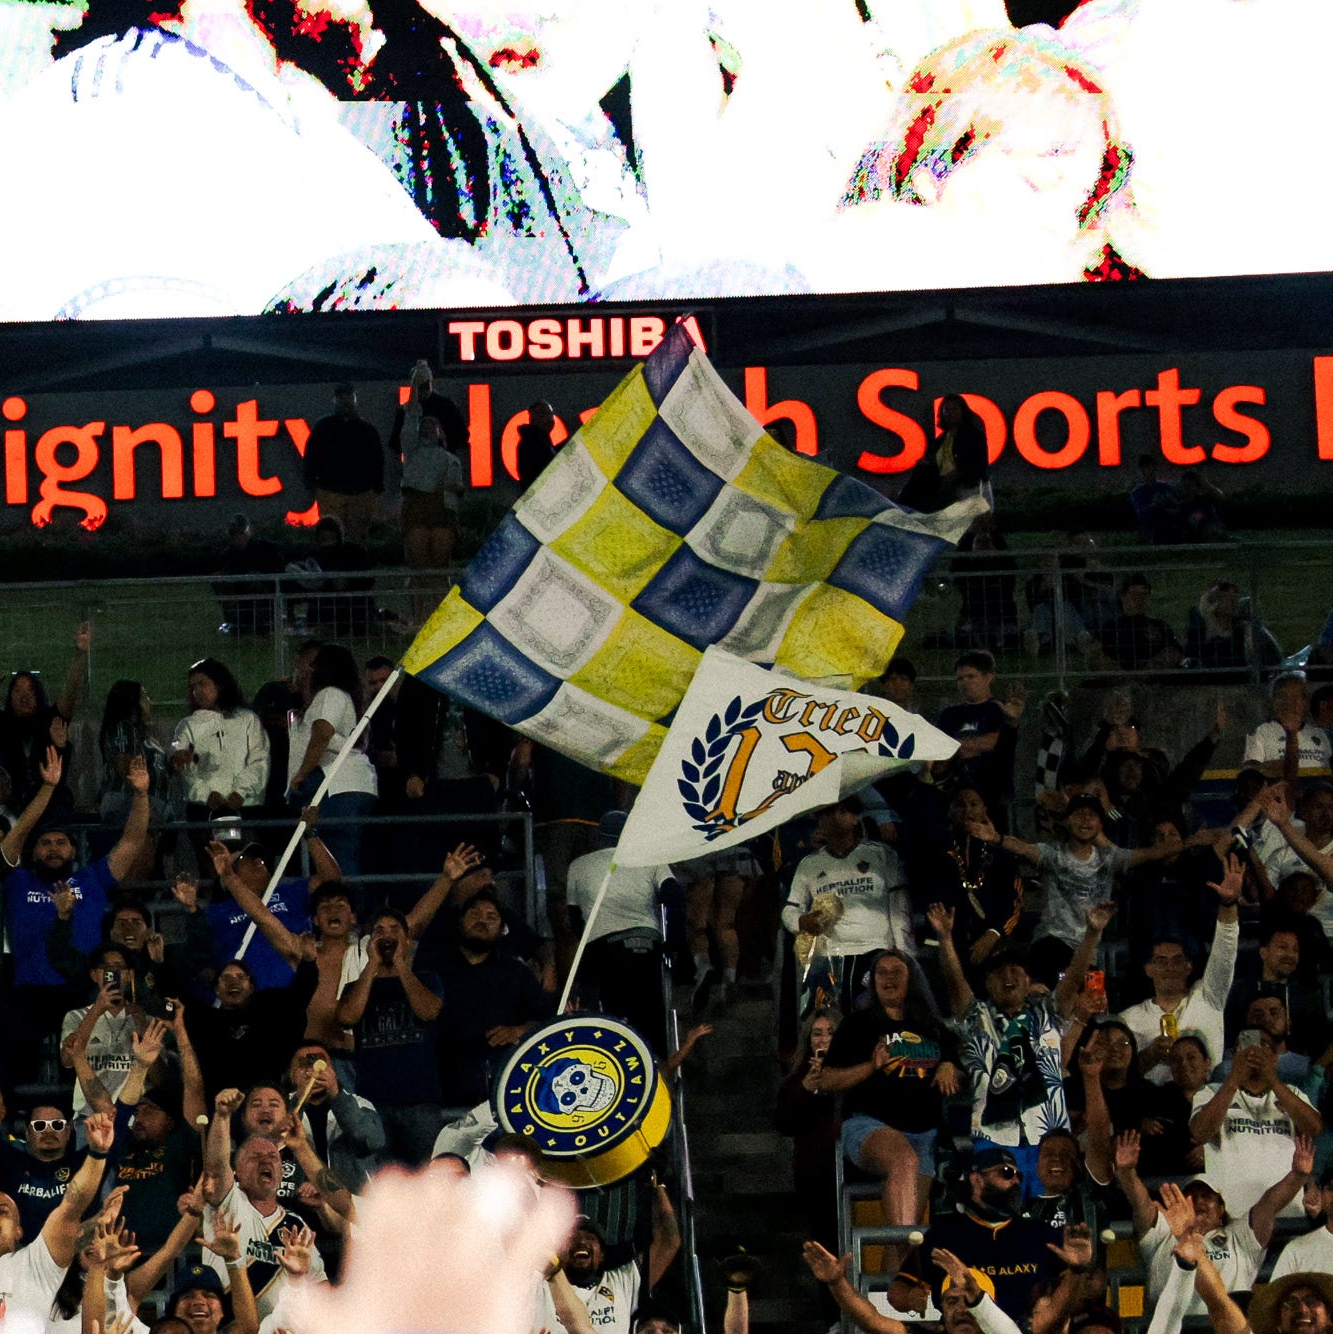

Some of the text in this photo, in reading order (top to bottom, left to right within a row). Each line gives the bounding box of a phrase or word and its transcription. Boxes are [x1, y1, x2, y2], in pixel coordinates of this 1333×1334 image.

[762, 687, 890, 744] Tried
[510, 1030, 576, 1138] GALAXY
[1229, 1126, 1293, 1137] NUTRITION
[17, 1183, 68, 1200] HERBALIF
